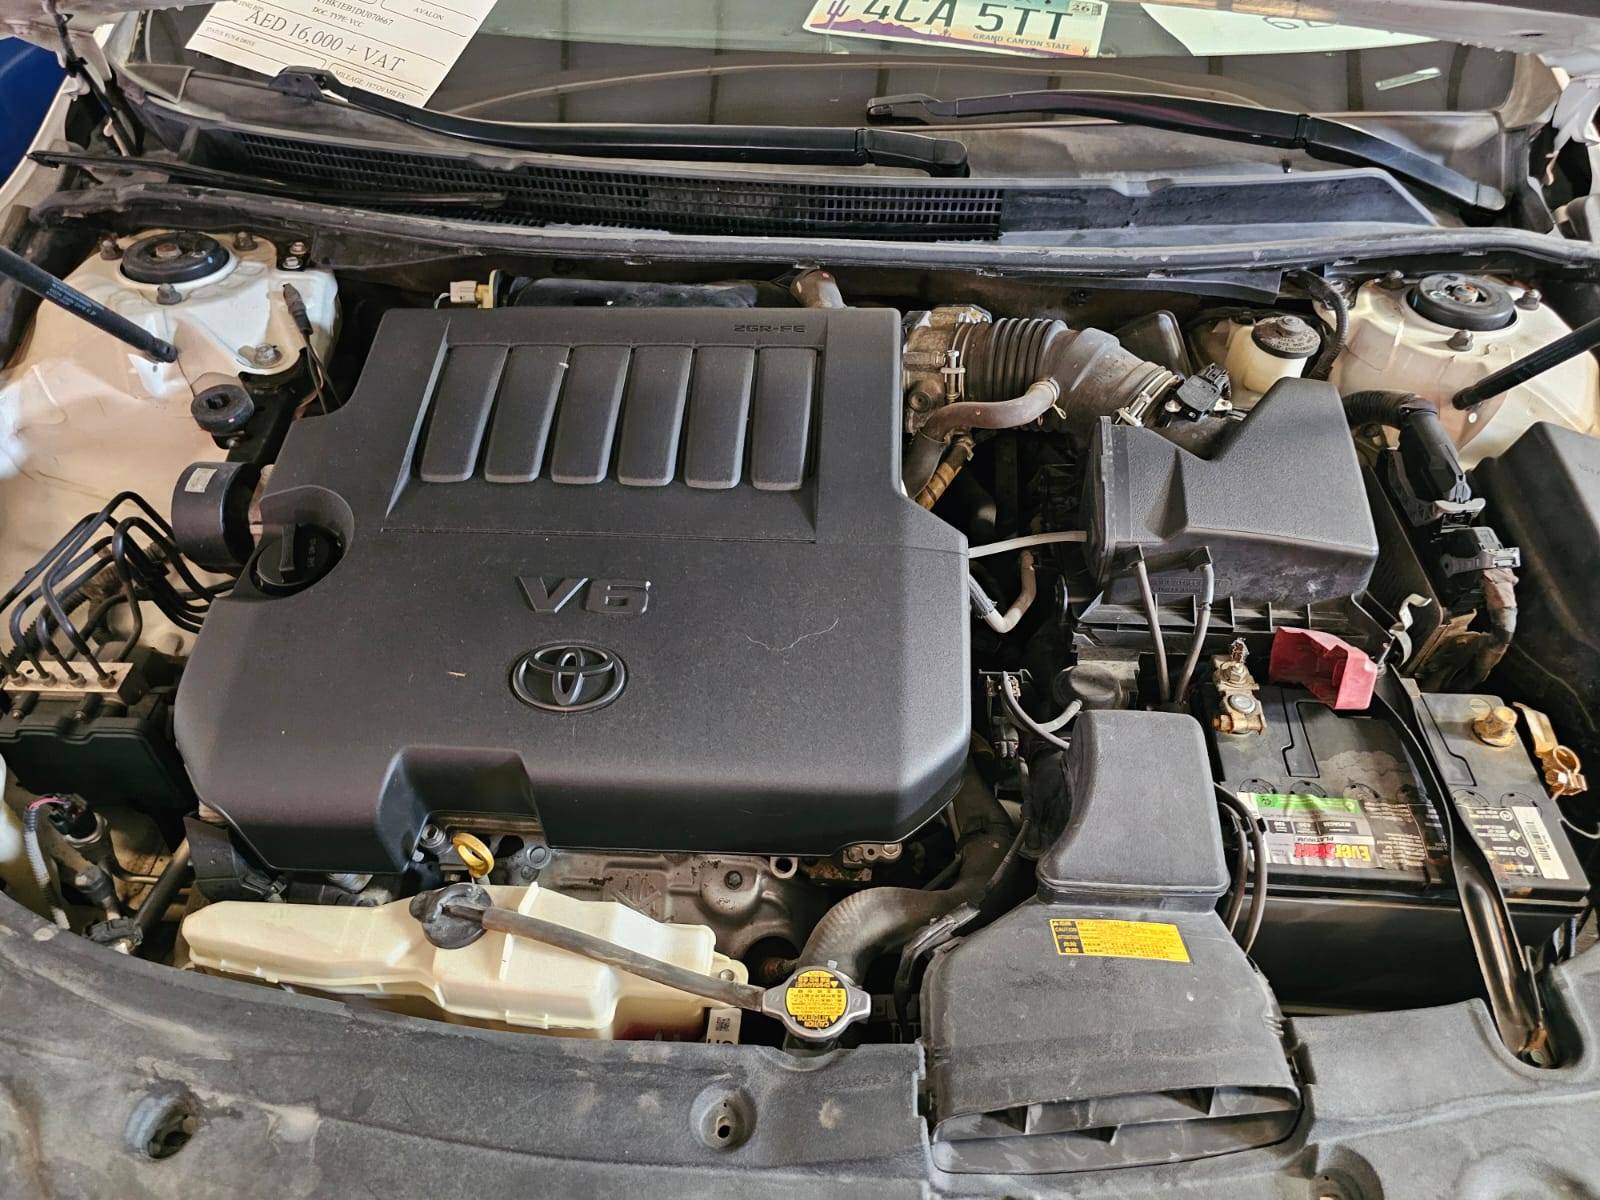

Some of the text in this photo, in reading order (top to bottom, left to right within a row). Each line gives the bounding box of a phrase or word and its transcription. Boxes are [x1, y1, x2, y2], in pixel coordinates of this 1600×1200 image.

[413, 7, 445, 21] AVALON
[974, 3, 1073, 40] 5TT
[245, 10, 287, 32] AED
[347, 44, 358, 55] +
[364, 47, 406, 71] VAT
[973, 33, 1072, 50] GRAND CANYON STATE
[734, 324, 806, 333] 2GR-FE
[517, 575, 653, 615] V6
